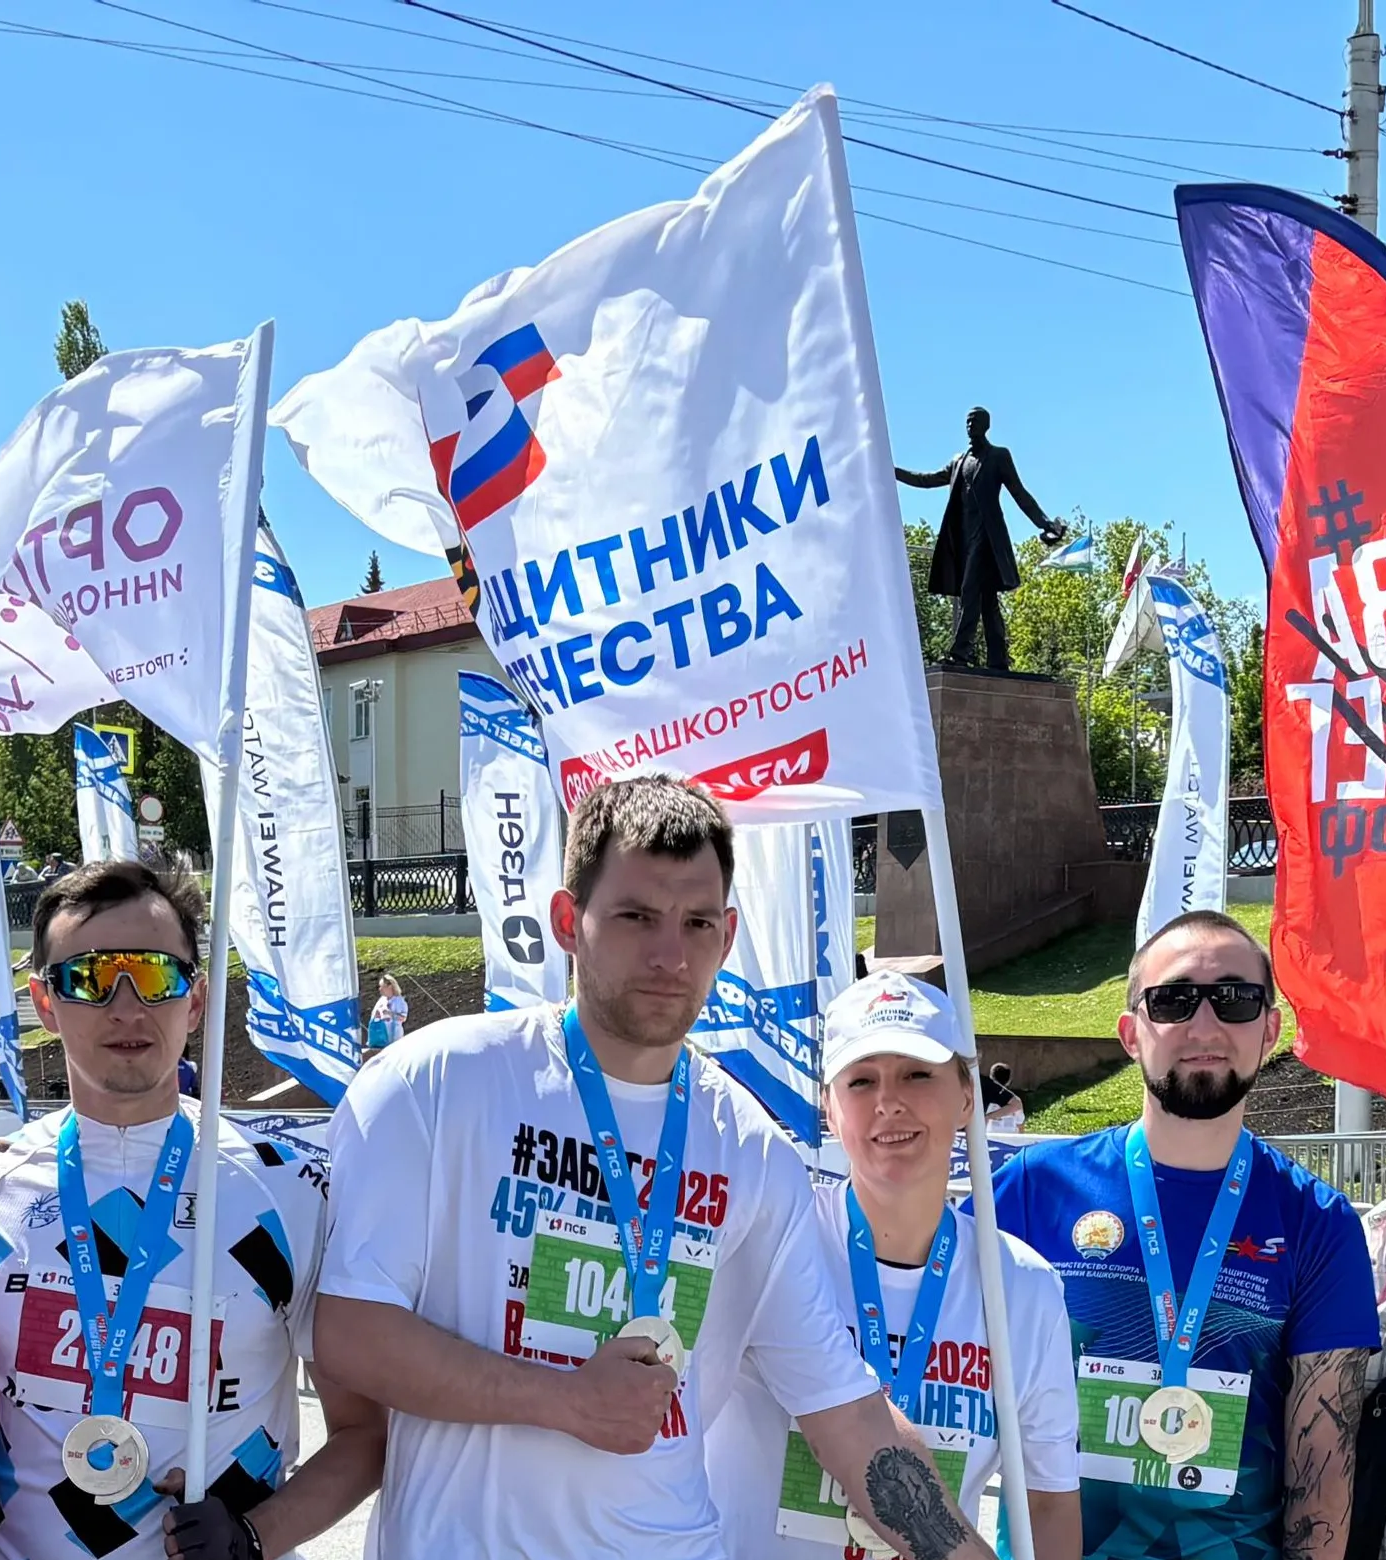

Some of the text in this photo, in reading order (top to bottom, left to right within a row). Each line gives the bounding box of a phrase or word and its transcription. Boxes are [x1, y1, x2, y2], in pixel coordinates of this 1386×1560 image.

[615, 638, 869, 769] БАШКОРТОСТАН
[165, 1146, 182, 1175] ПСБ
[606, 1149, 623, 1179] ПСБ
[1233, 1157, 1248, 1181] ПСБ
[563, 1221, 587, 1236] ПСБ
[648, 1228, 664, 1257] ПСБ
[937, 1235, 951, 1262] ПСБ
[1145, 1231, 1160, 1256] ПСБ
[77, 1242, 93, 1274] ПСБ
[564, 1257, 678, 1323] 1044
[866, 1318, 881, 1346] ПСБ
[1183, 1307, 1199, 1335] ПСБ
[109, 1328, 127, 1359] ПСБ
[1103, 1364, 1125, 1375] ПСБ
